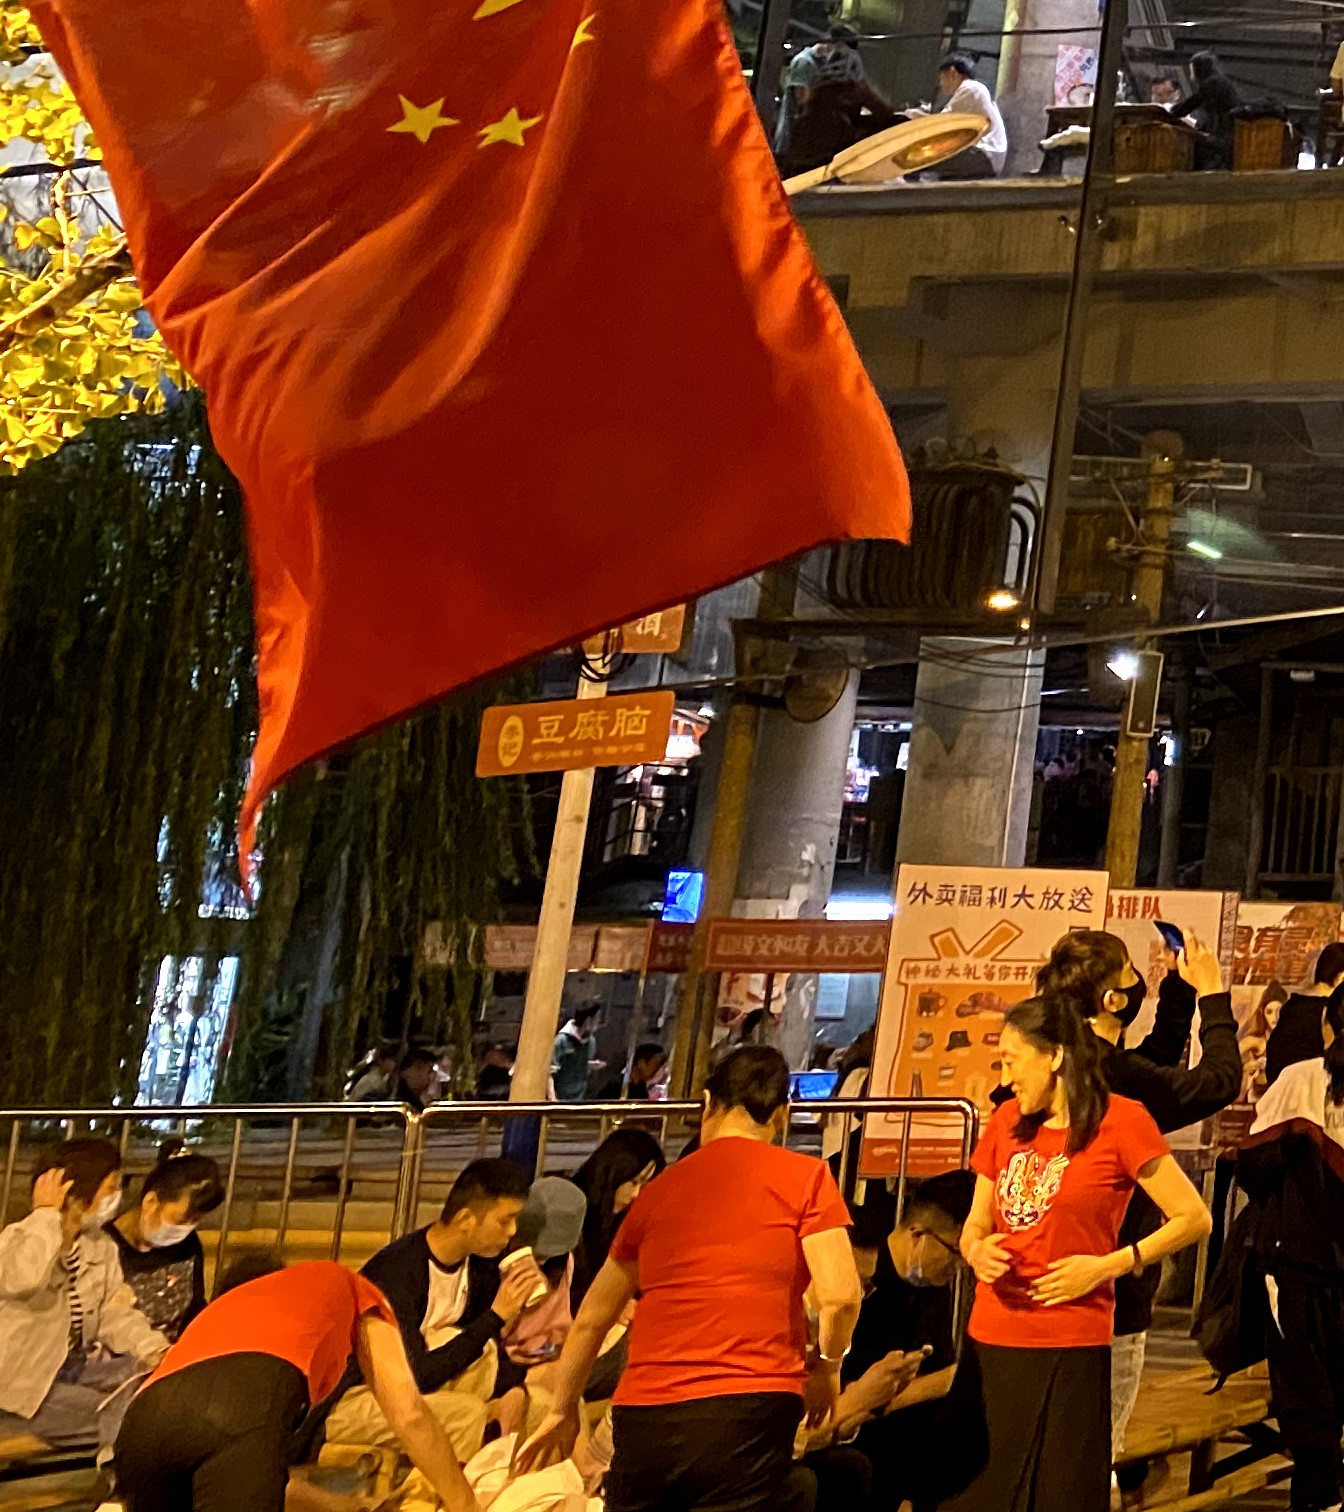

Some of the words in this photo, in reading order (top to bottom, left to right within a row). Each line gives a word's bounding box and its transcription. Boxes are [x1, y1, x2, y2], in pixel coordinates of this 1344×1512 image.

[531, 705, 652, 745] 豆腐脑
[906, 880, 1095, 914] 外卖福利大放送
